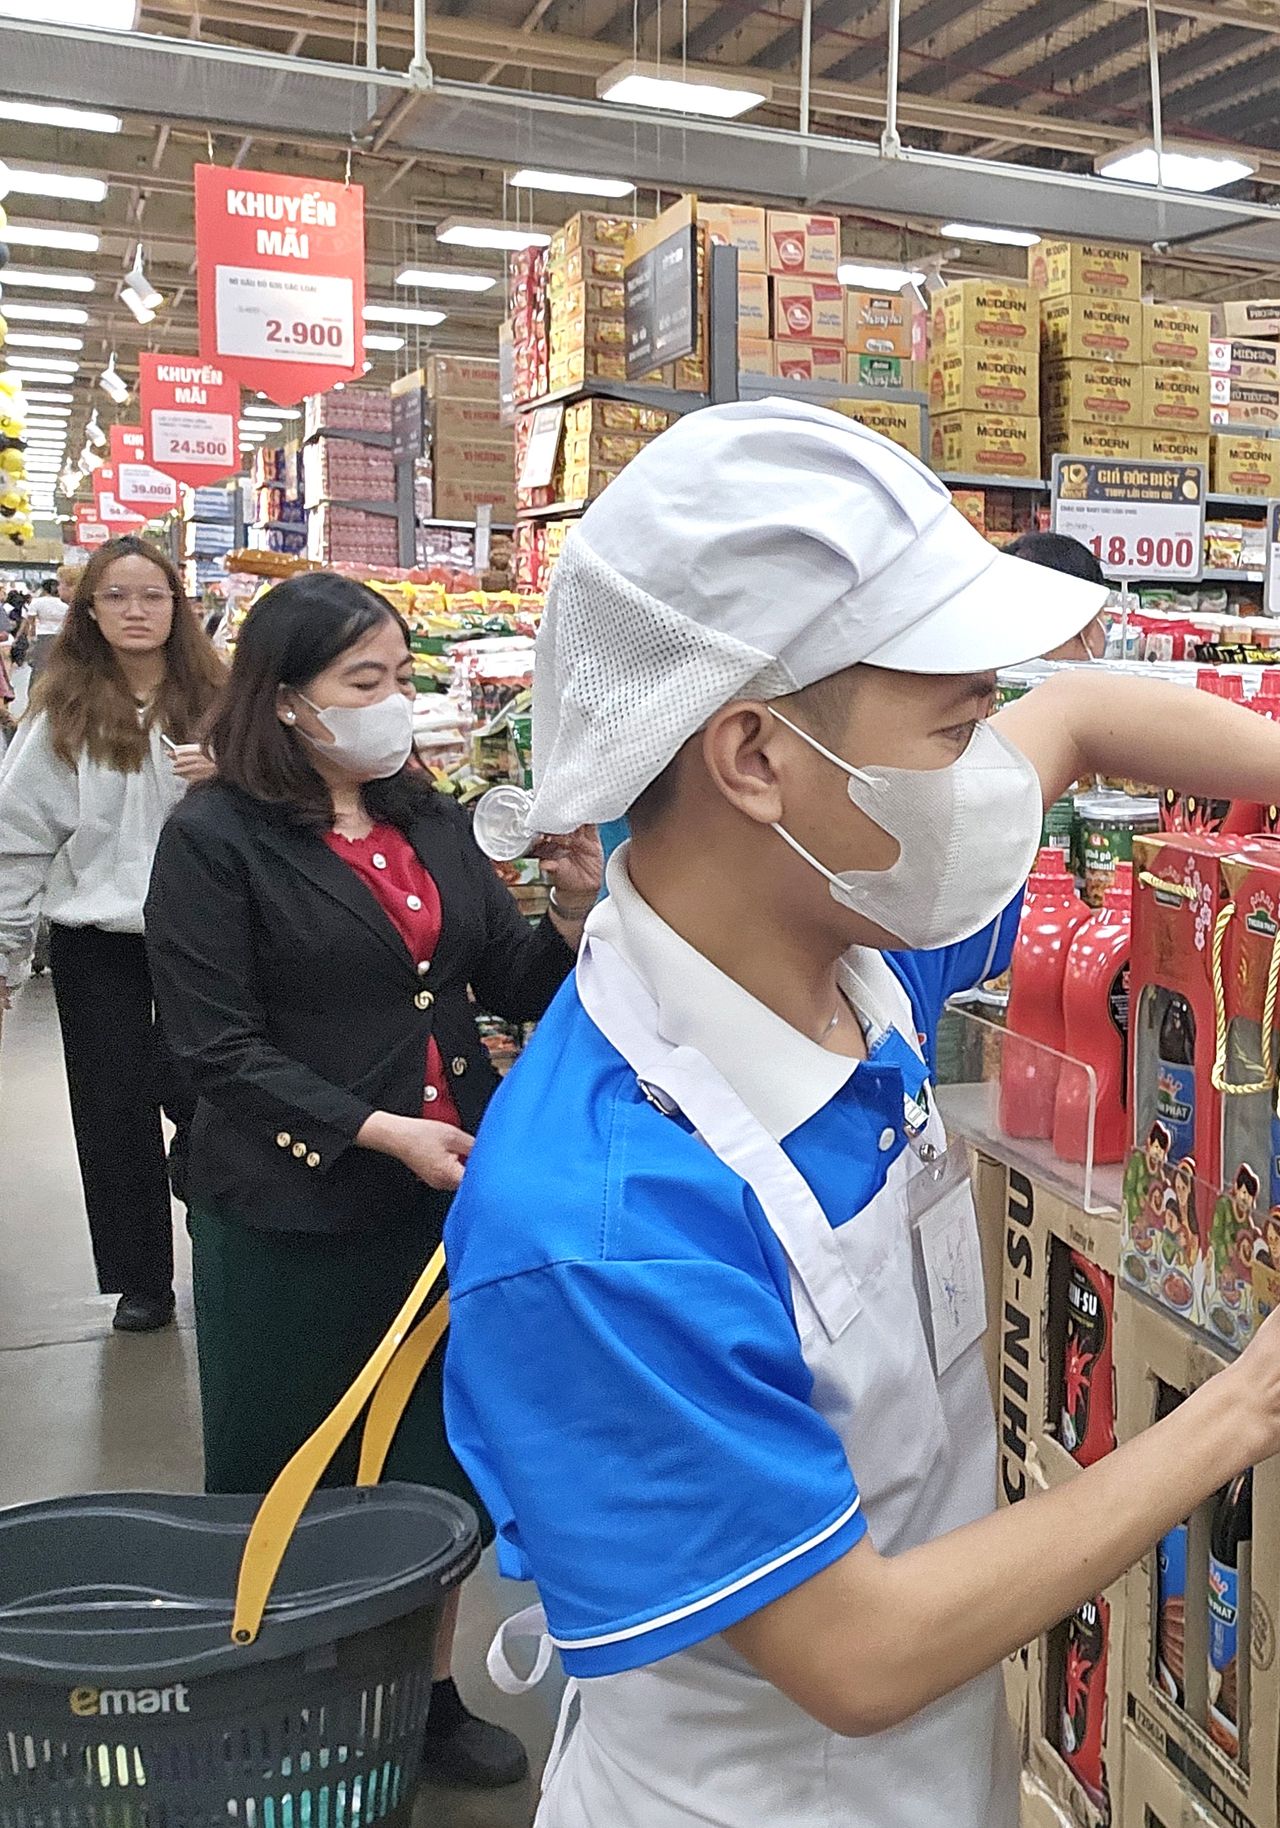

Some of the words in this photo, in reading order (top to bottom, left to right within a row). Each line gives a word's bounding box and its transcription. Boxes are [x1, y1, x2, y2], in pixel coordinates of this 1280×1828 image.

[226, 189, 336, 227] KHUYẾN
[257, 227, 310, 259] MÃI
[1082, 246, 1129, 262] MODERN
[976, 296, 1027, 312] MODERN
[1083, 309, 1130, 325] MODERN
[266, 319, 343, 348] 2.900
[1154, 319, 1199, 334] MODERN
[157, 365, 223, 385] KHUYẾN
[976, 360, 1026, 376] MODERN
[1084, 372, 1131, 388] MODERN
[1154, 380, 1200, 395] MODERN
[175, 387, 207, 405] MÃI
[976, 425, 1026, 441] MODERN
[170, 439, 227, 456] 24.500
[1083, 435, 1129, 450] MODERN
[1152, 441, 1198, 456] MODERN
[1229, 448, 1272, 463] MODERN
[1150, 470, 1180, 488] BIỆT
[1089, 535, 1193, 568] 18.900
[1001, 1166, 1035, 1504] CHIN-SU
[71, 1683, 190, 1717] emart
